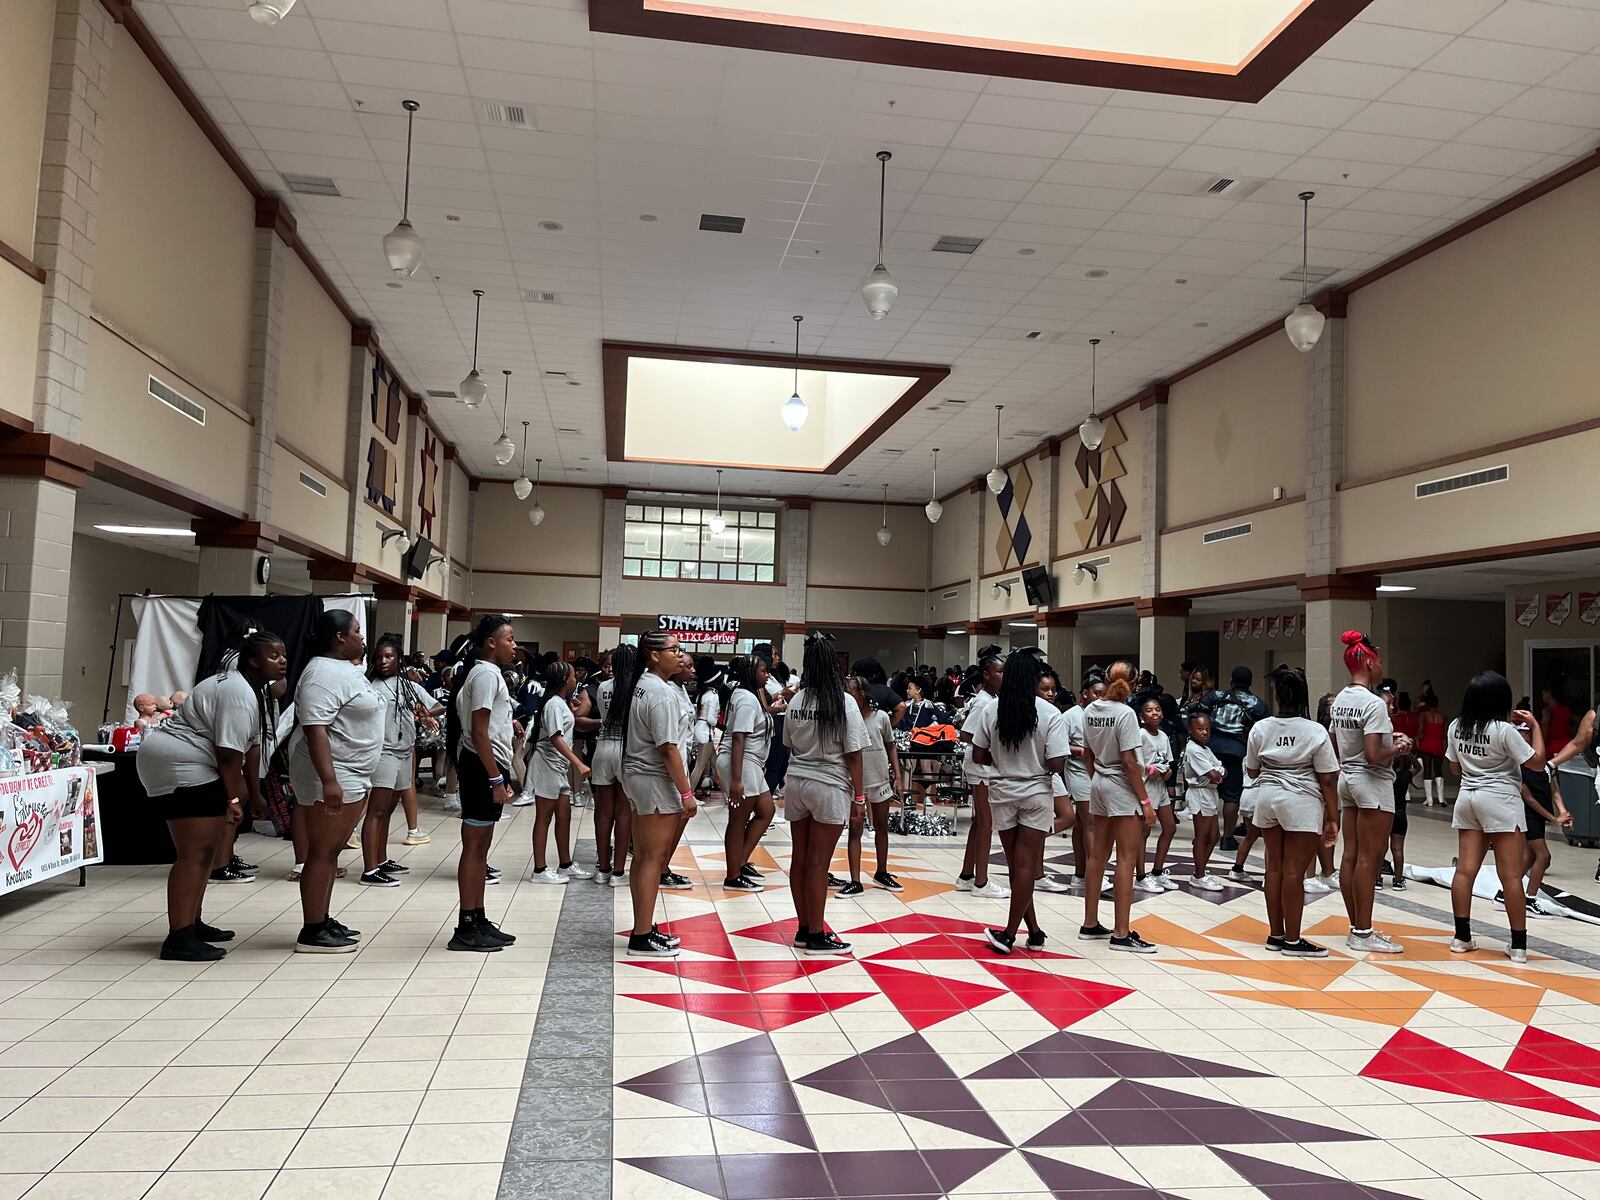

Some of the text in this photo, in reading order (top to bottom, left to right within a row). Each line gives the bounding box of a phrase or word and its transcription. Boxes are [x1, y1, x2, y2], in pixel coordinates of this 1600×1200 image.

[659, 615, 739, 632] STAY ALIVE!
[684, 633, 702, 641] TXT
[704, 633, 711, 642] &
[712, 632, 735, 643] drive
[1276, 736, 1296, 747] JAY
[1454, 729, 1491, 745] CAPAIN
[1458, 742, 1488, 757] ANGEL
[5, 867, 32, 886] Kreations
